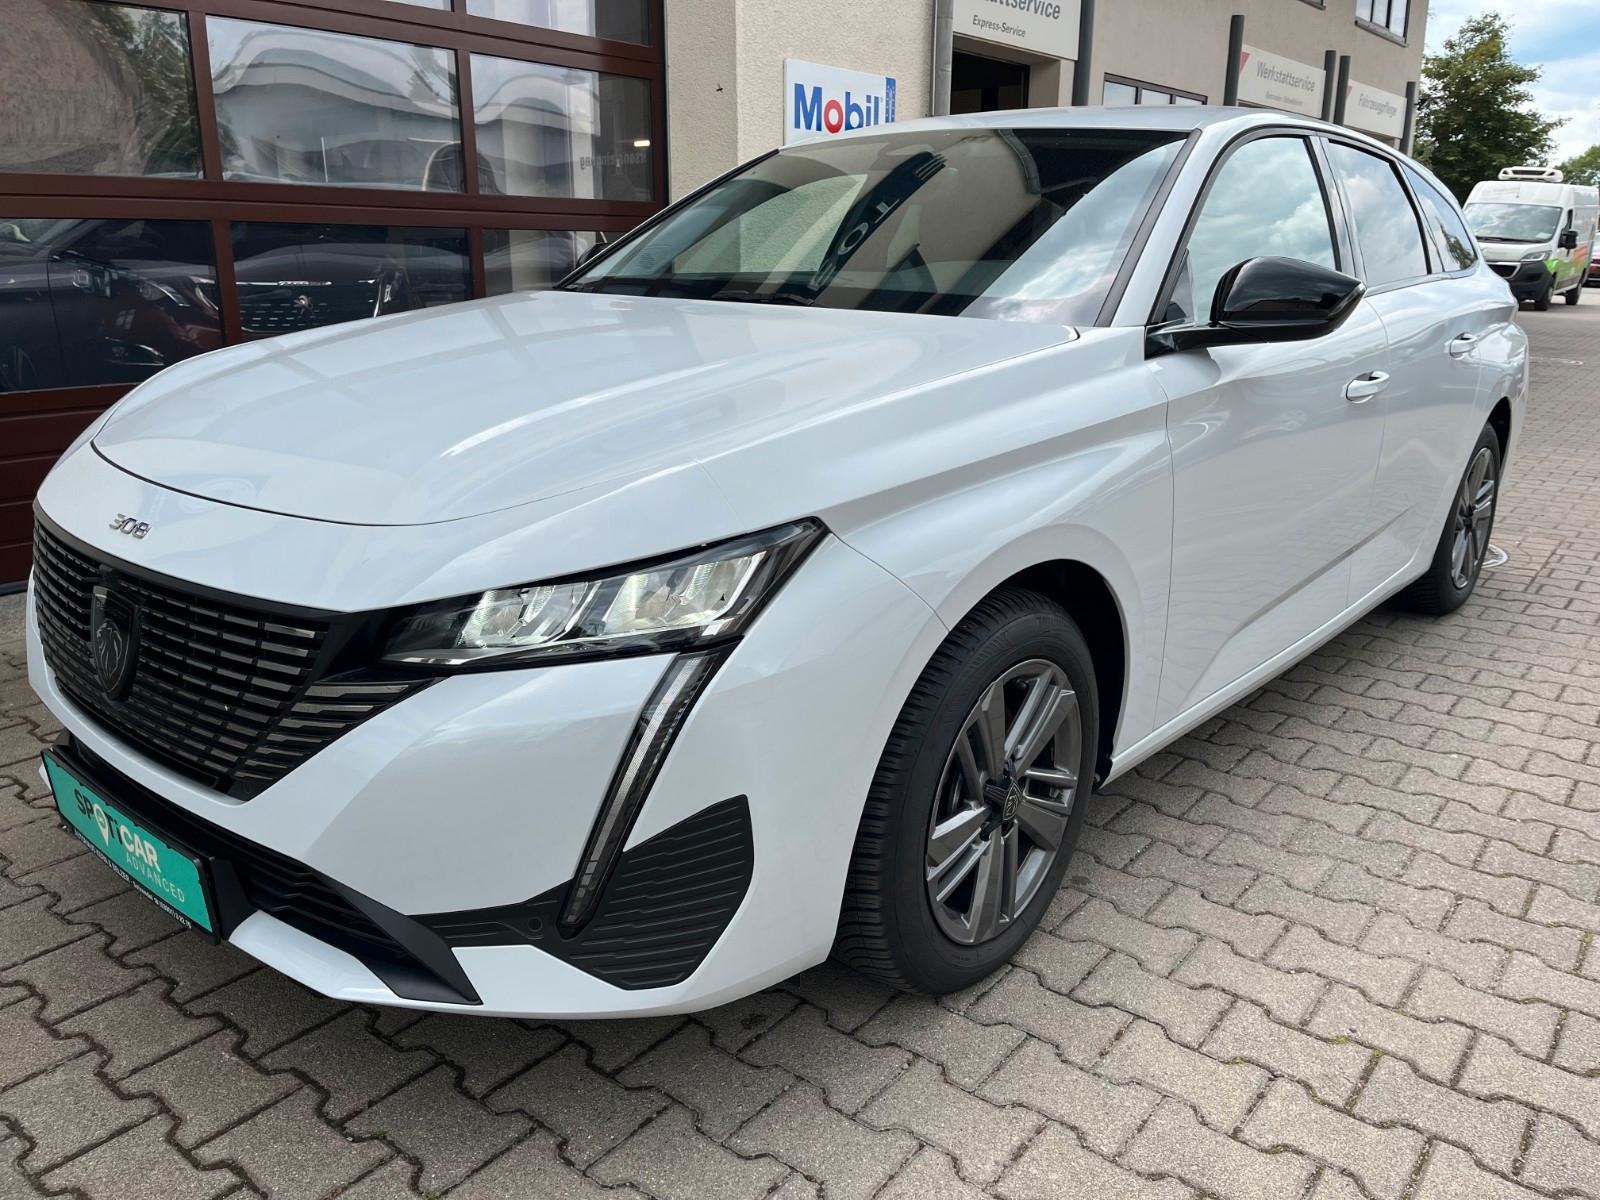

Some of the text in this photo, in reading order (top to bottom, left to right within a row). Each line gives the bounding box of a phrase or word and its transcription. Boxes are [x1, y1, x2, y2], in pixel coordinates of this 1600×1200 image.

[972, 14, 1026, 37] Express-Service
[1257, 61, 1316, 92] Werkstattservice
[794, 82, 880, 134] Mobil
[108, 512, 152, 540] 308
[125, 851, 186, 904] ADVANCED
